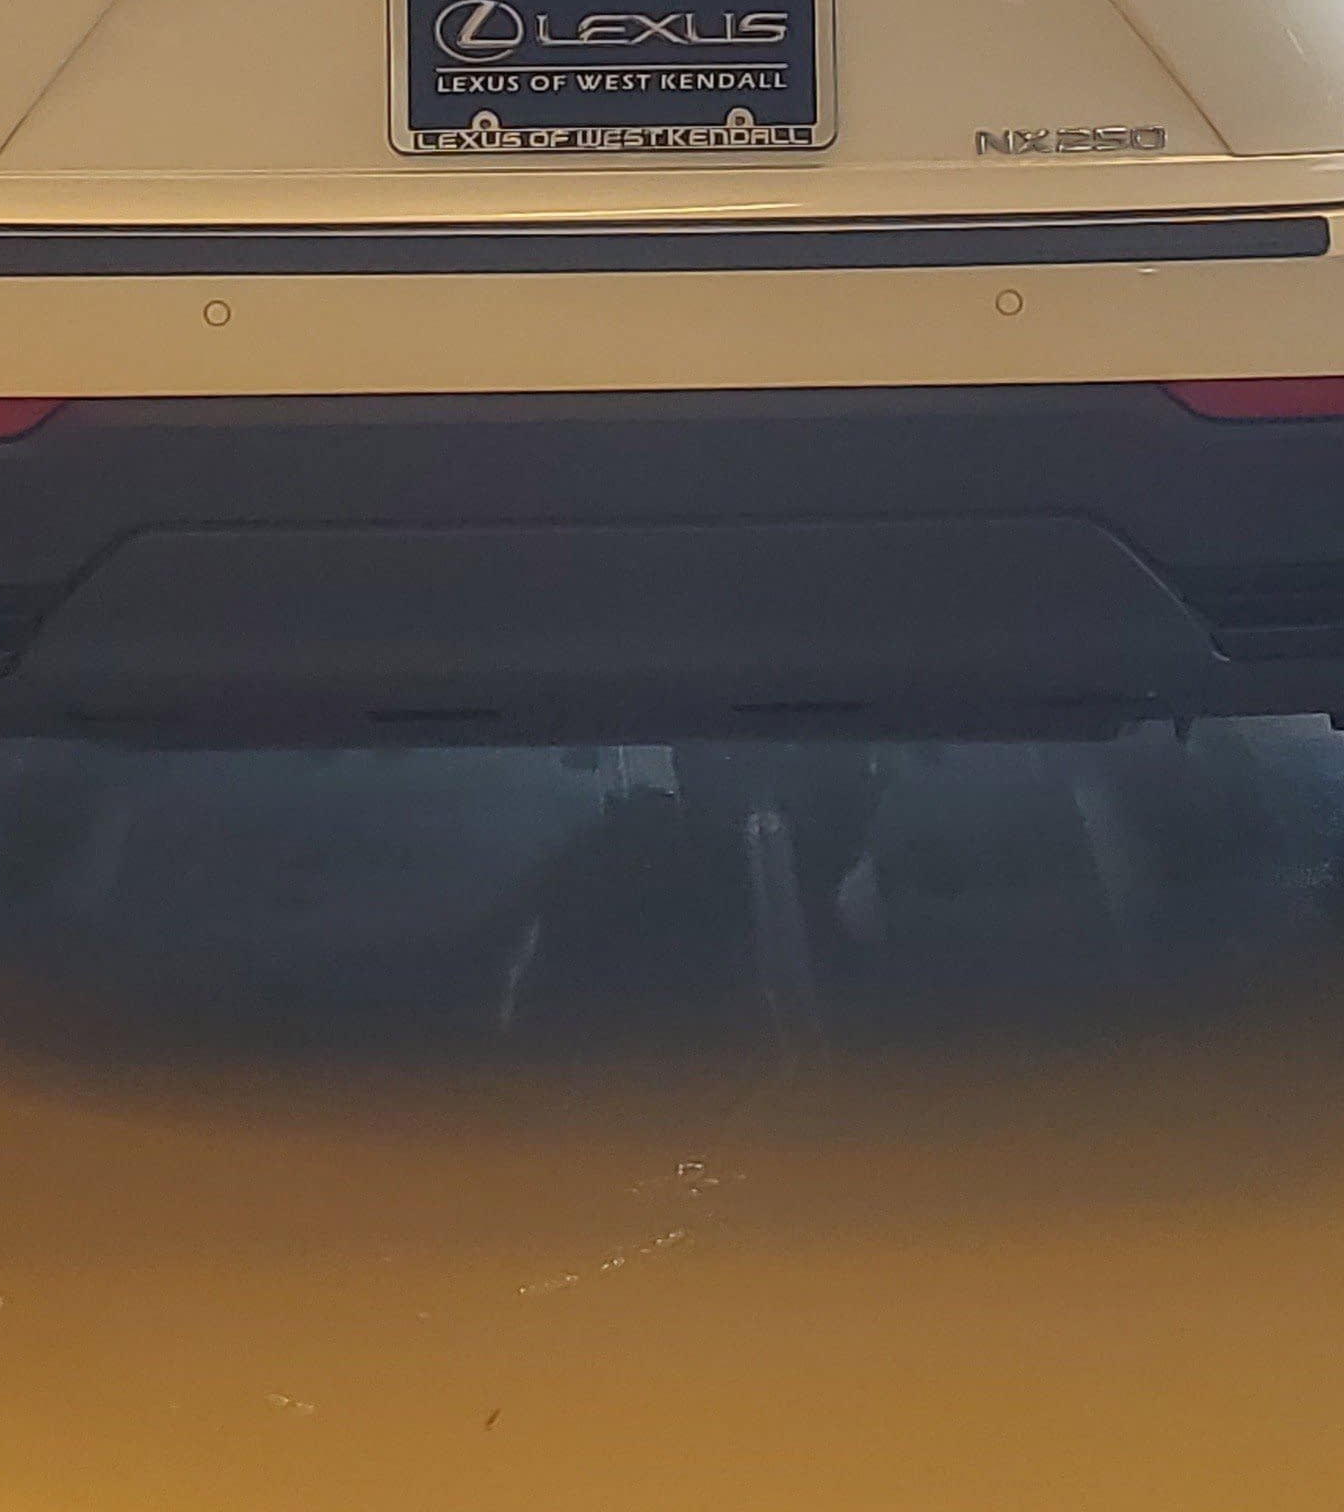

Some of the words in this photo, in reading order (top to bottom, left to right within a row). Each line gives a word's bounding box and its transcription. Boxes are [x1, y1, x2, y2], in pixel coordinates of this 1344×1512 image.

[536, 11, 789, 45] LEXUS
[437, 75, 520, 93] LEXUS
[529, 75, 567, 92] OF
[576, 73, 653, 91] WEST
[660, 72, 788, 90] KENDALL
[417, 131, 522, 150] LEXUS
[528, 131, 570, 148] OF
[575, 128, 663, 148] WEST
[667, 126, 810, 147] KENDALL
